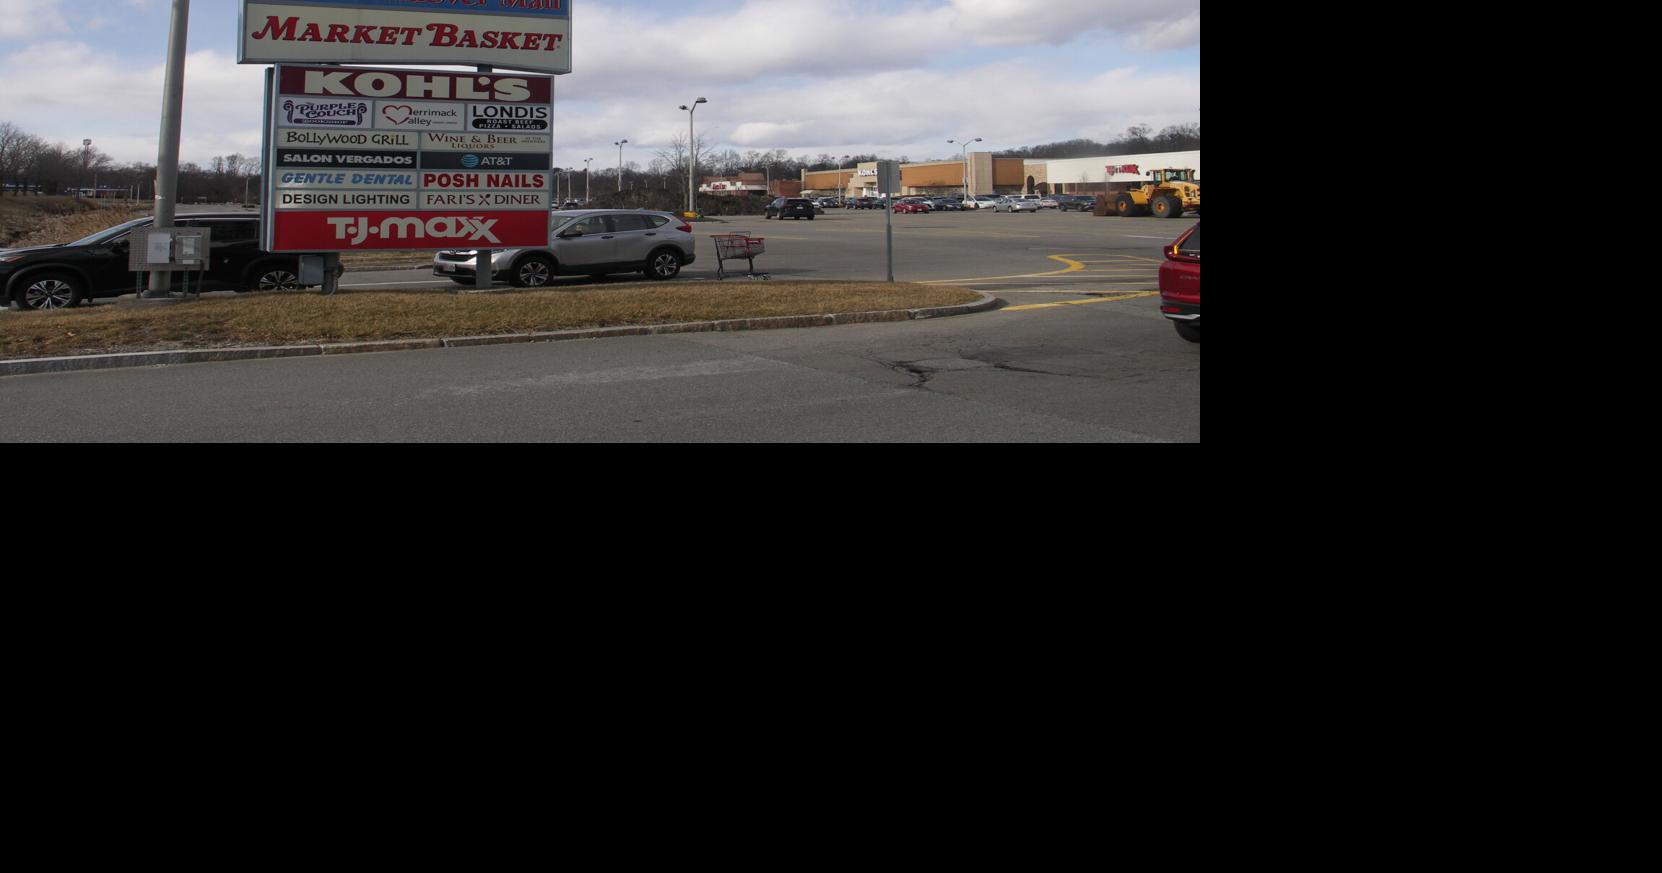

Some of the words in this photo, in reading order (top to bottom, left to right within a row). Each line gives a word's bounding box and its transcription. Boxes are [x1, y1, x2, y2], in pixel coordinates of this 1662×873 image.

[251, 15, 422, 45] MARKET
[426, 23, 563, 52] BASKET
[304, 70, 531, 101] KOHL'S
[295, 102, 357, 115] PURPLE
[305, 109, 357, 119] COUCH
[472, 105, 548, 119] LONDIS
[428, 132, 467, 143] WINE
[471, 135, 481, 144] &
[487, 133, 518, 144] BEER
[283, 154, 332, 163] SALON
[336, 155, 413, 165] VERGADOS
[480, 156, 513, 166] AT&T
[281, 172, 345, 184] GENTLE
[351, 173, 413, 185] DENTAL
[423, 173, 479, 188] POSH
[486, 174, 544, 188] NAILS
[282, 194, 338, 205] DESIGN
[343, 194, 410, 205] LIGHTING
[426, 194, 476, 205] FARI'S
[494, 194, 541, 205] DINER
